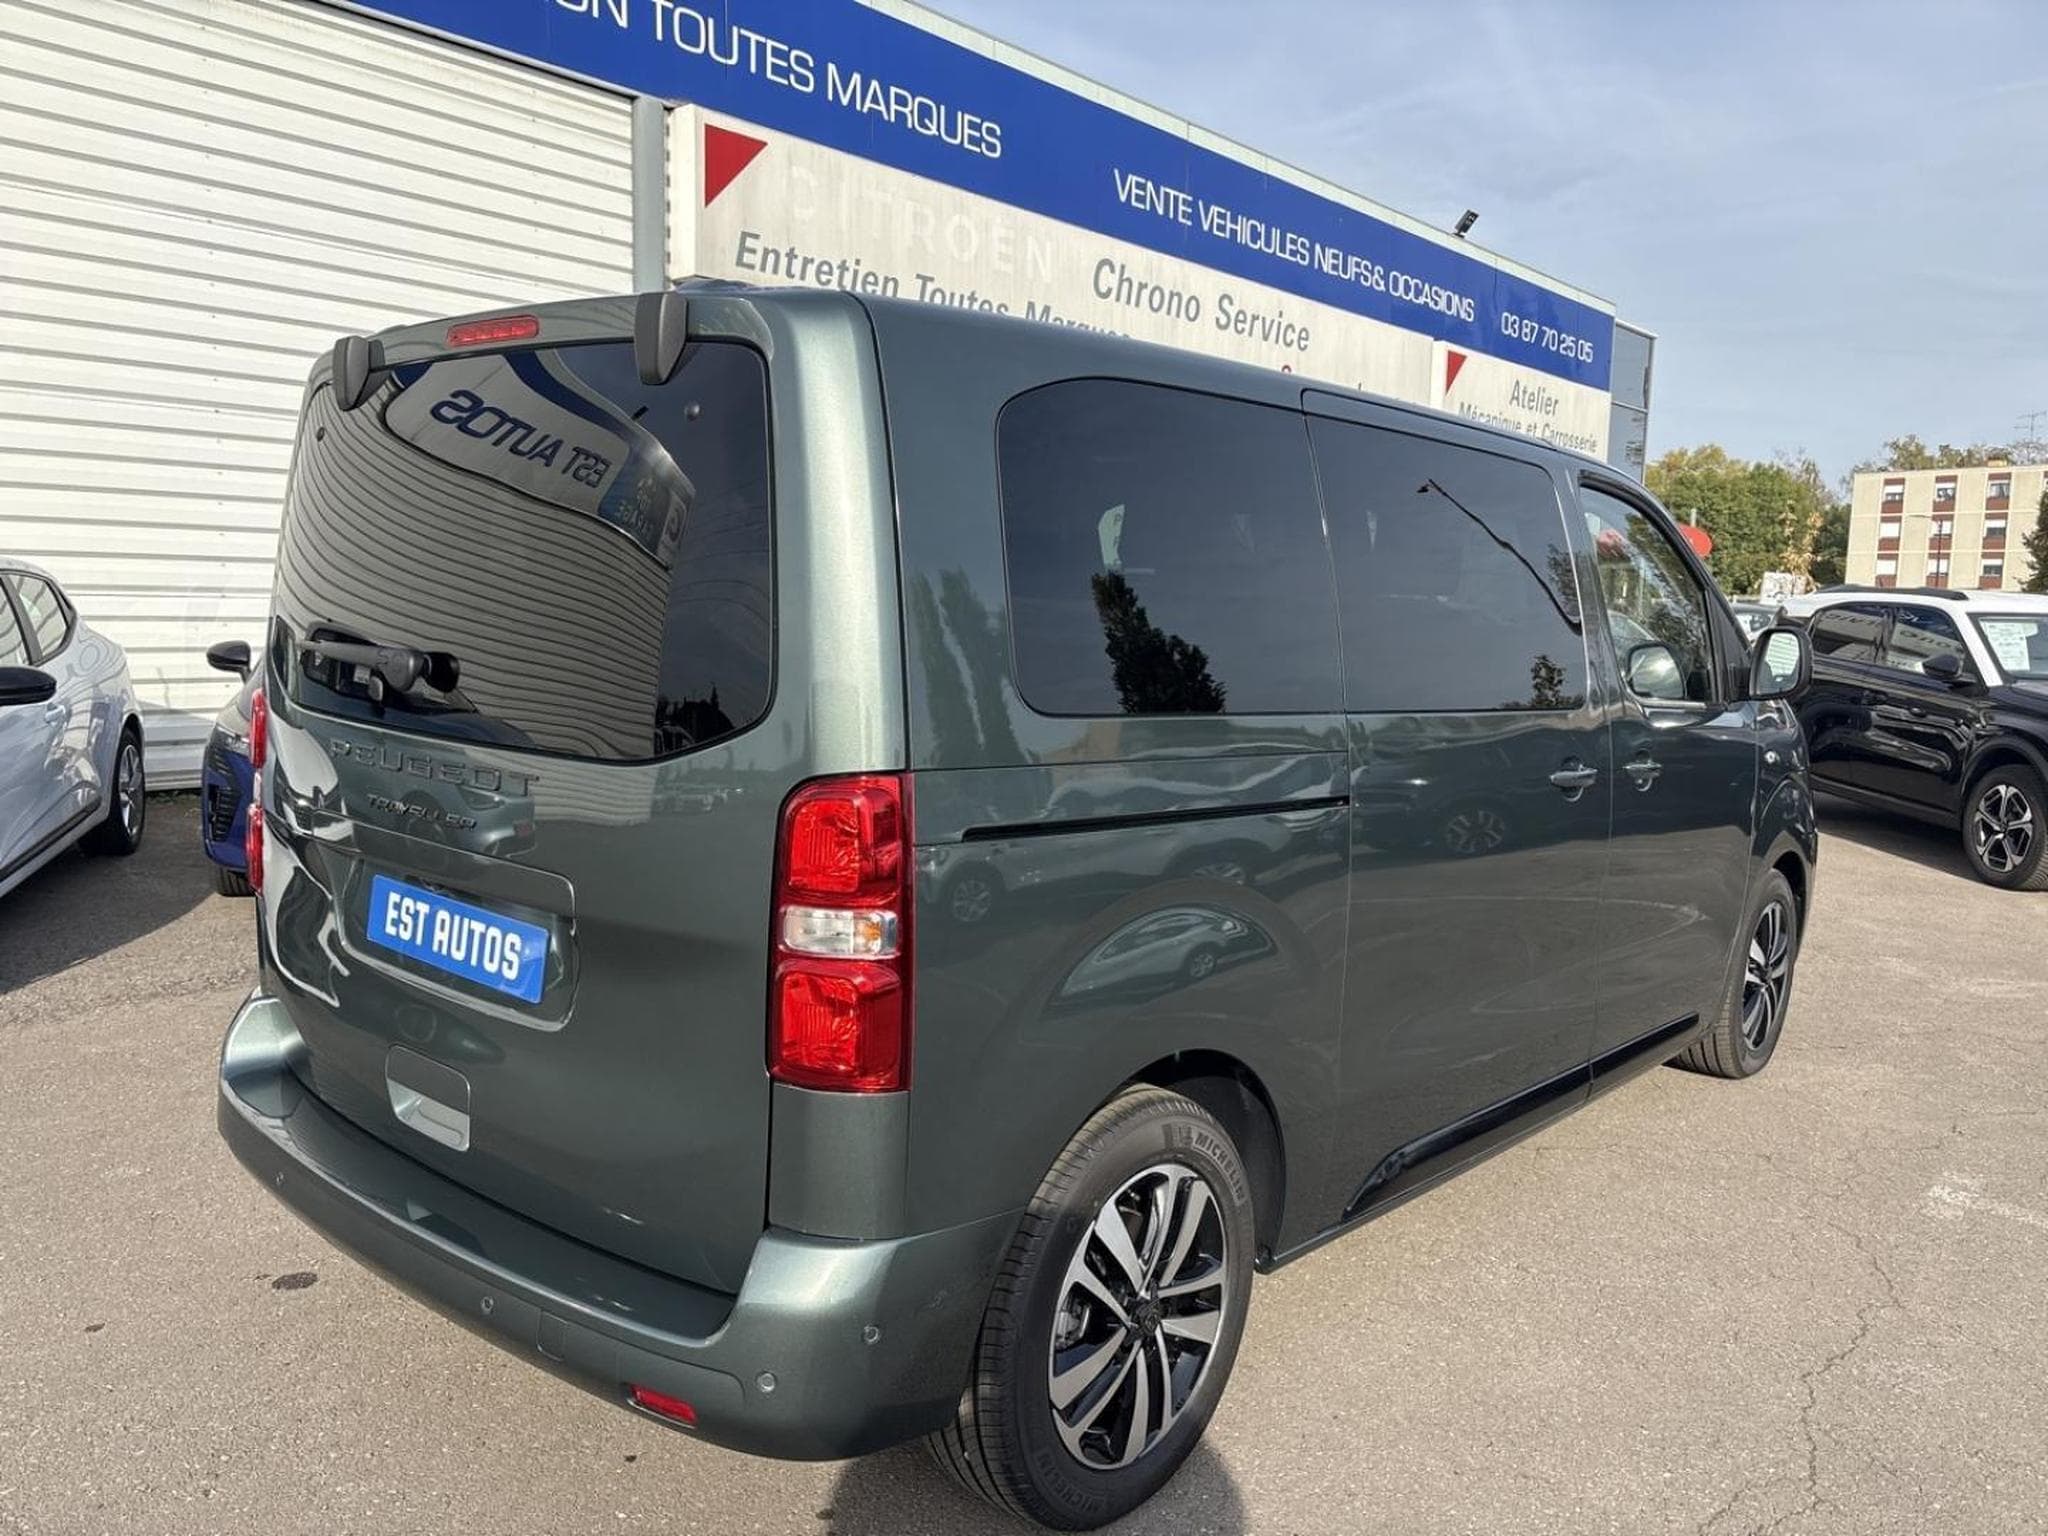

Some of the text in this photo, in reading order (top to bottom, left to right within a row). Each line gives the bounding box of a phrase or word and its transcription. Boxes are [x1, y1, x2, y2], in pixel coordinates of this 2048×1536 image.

[653, 0, 1002, 159] TOUTES MARQUES
[735, 230, 900, 298] Entretien
[1113, 167, 1193, 226] VENTE
[1198, 199, 1310, 266] VEHICULES
[1388, 271, 1475, 323] OCCASIONS
[1092, 257, 1201, 323] Chrono
[1215, 293, 1310, 352] Service
[1500, 311, 1594, 364] 03 87 70 25 05
[1508, 379, 1560, 417] Atelier
[330, 738, 541, 798] PEUGEOT
[366, 793, 478, 832] TRAVELLER
[384, 890, 522, 981] EST AUTOS
[1194, 1131, 1245, 1201] MICHELIN
